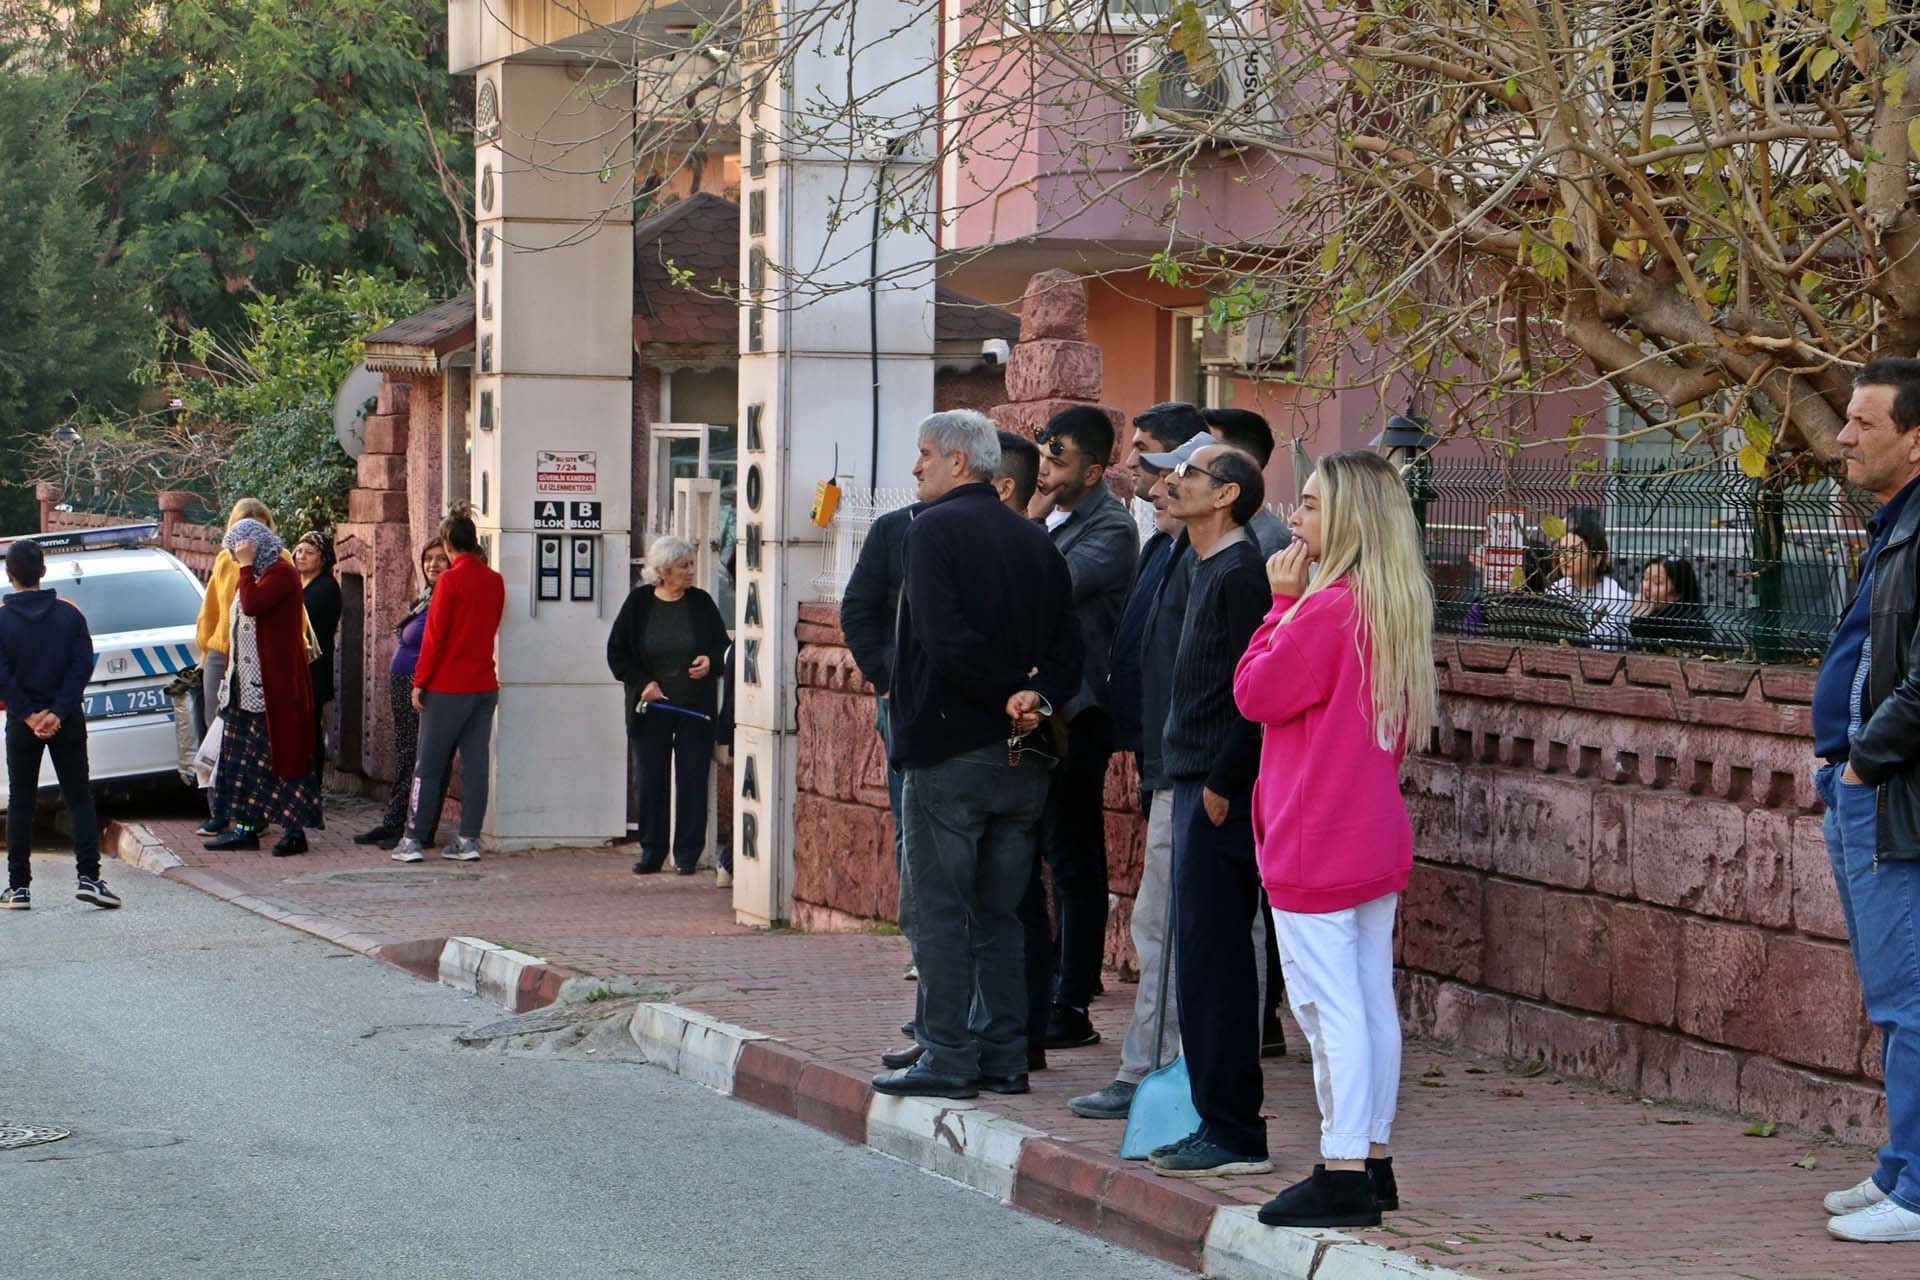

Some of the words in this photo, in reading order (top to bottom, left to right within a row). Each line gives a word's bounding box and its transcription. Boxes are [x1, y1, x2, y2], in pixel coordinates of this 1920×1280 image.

[542, 502, 557, 517] A
[578, 502, 592, 517] B
[534, 519, 564, 528] BLOK
[570, 520, 600, 528] BLOK
[105, 695, 114, 712] A
[127, 688, 166, 709] 7251
